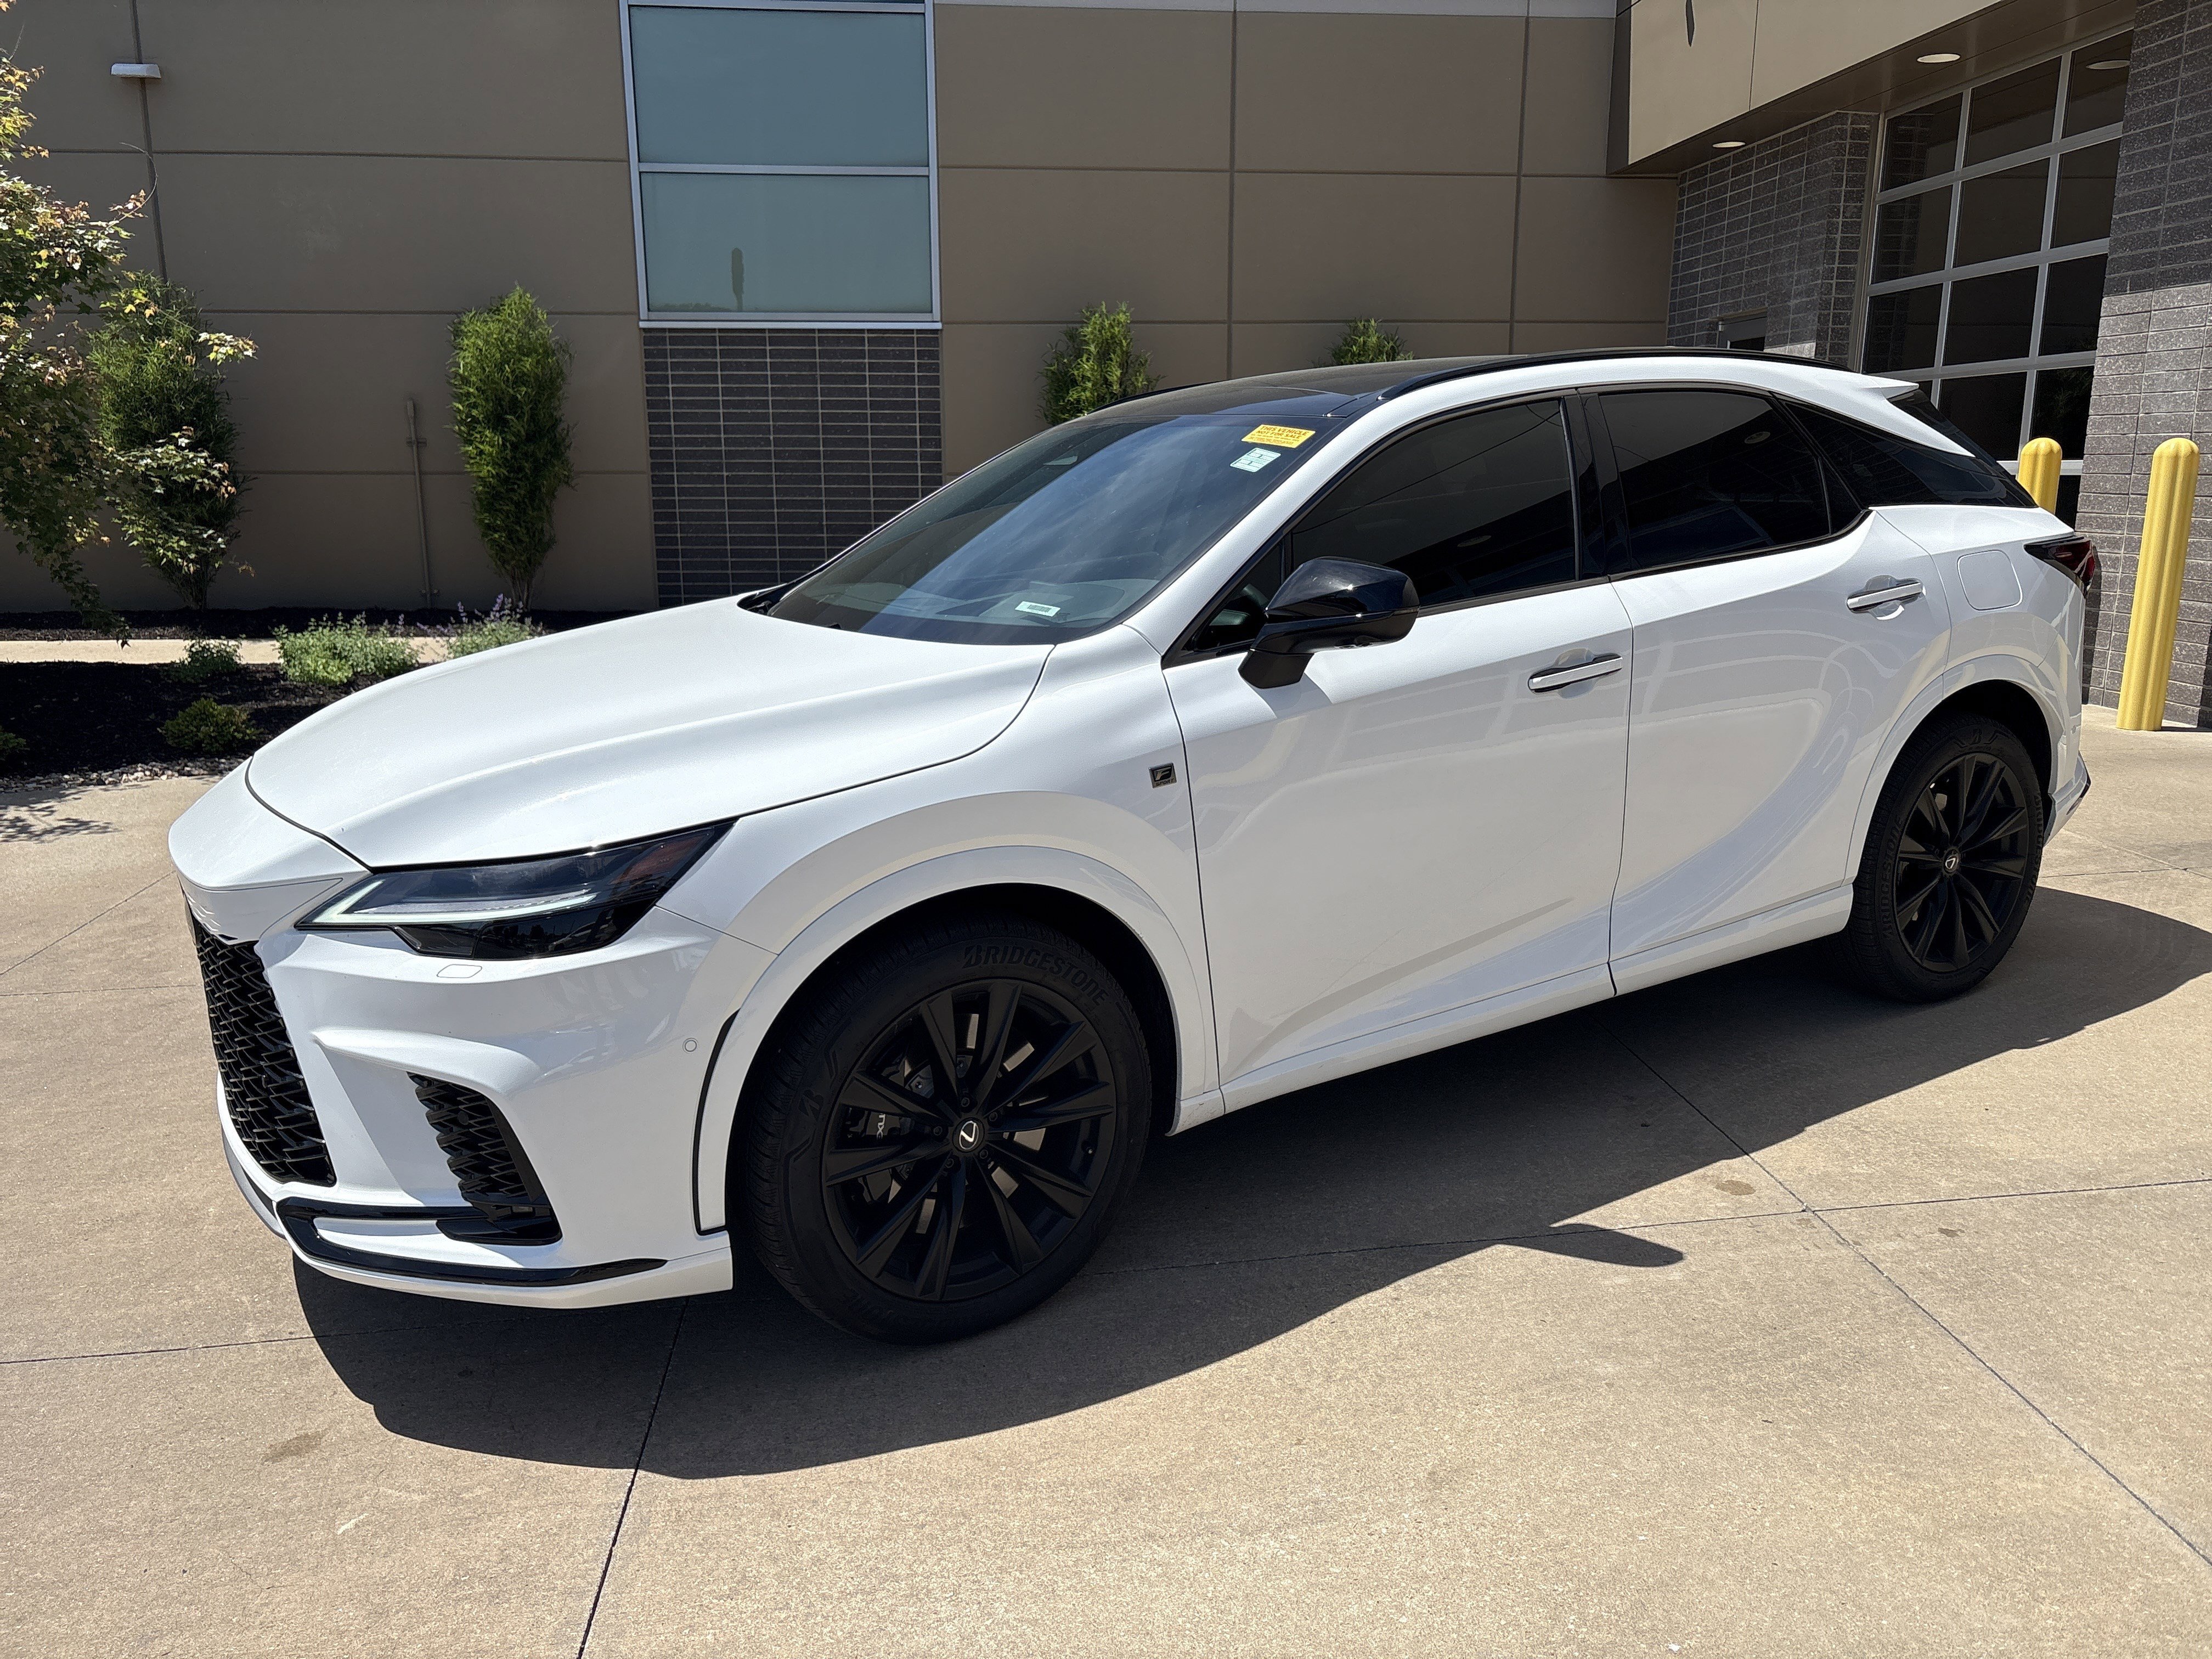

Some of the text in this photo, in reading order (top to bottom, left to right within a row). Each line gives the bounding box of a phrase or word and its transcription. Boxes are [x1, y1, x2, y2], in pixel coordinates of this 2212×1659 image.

[1277, 427, 1310, 436] VEHICLE
[1881, 814, 1903, 939] BRIDGESTONE
[962, 944, 1109, 1006] BRIDGESTONE
